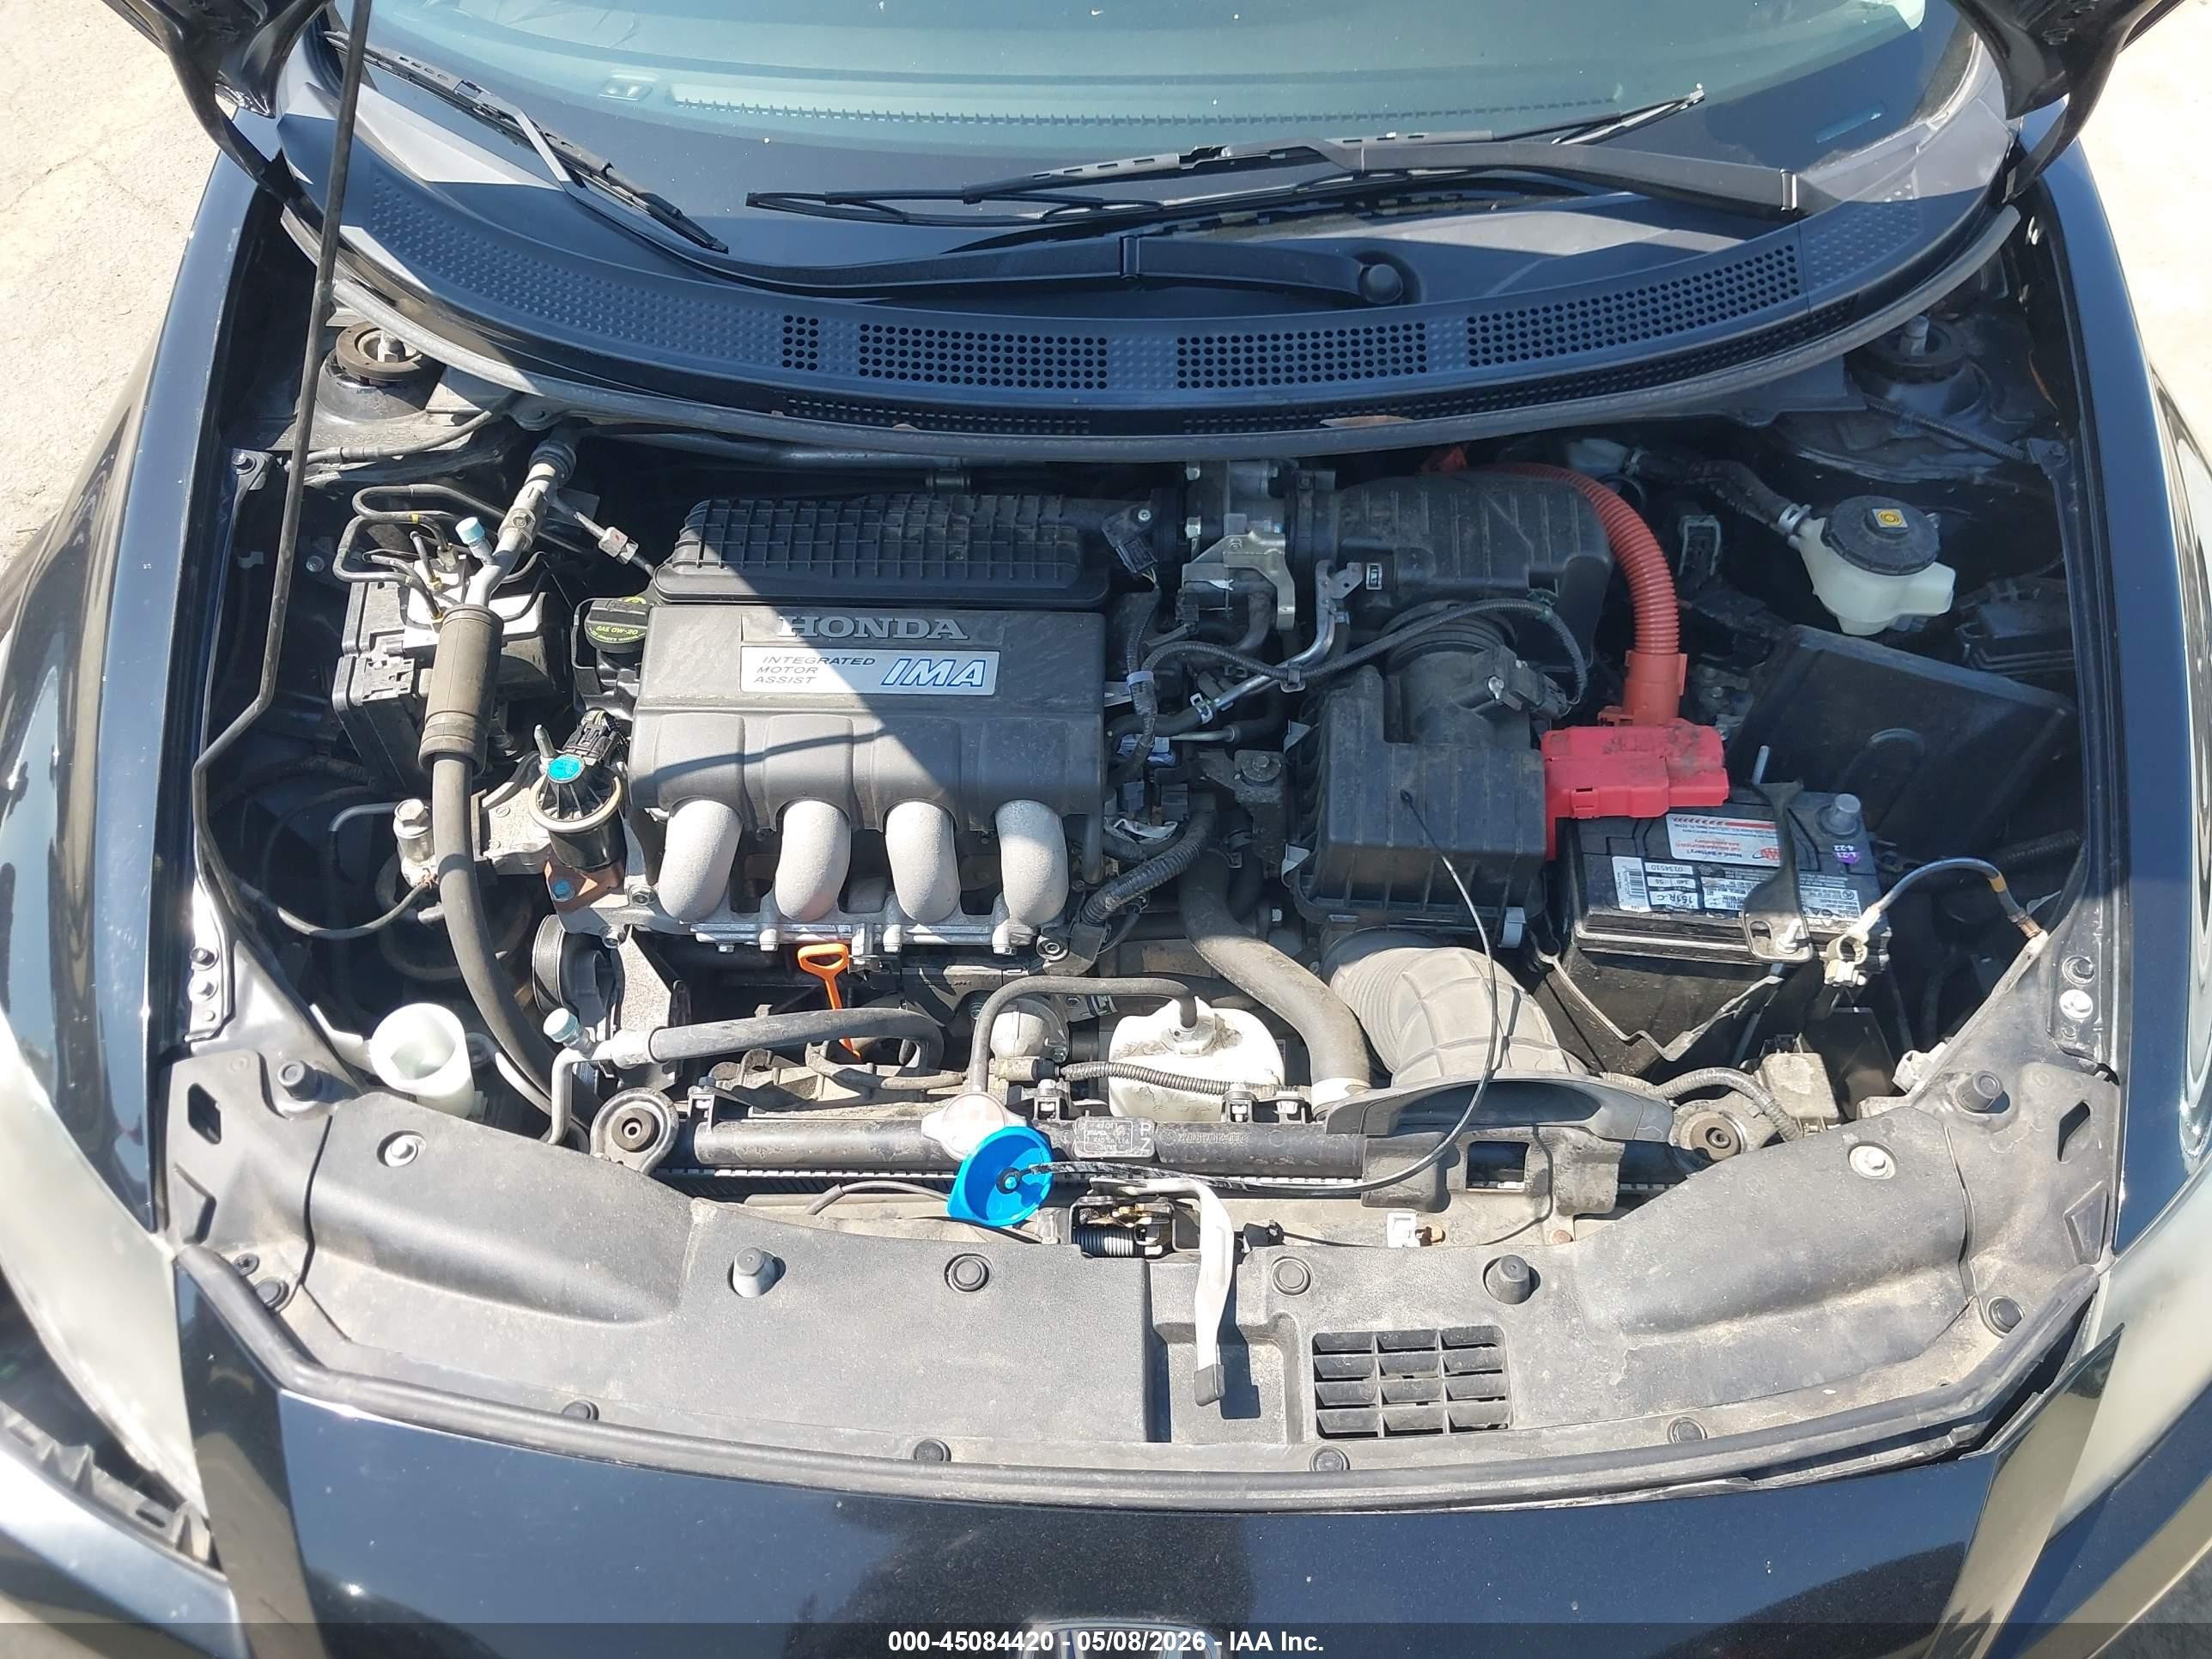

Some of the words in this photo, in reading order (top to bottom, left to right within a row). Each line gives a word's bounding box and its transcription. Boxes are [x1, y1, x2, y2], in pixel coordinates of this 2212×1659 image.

[776, 616, 969, 640] HONDA
[763, 656, 875, 665] INTEGRATED
[880, 658, 986, 687] IMA
[1656, 893, 1693, 904] 151R-C
[1139, 1122, 1152, 1136] P
